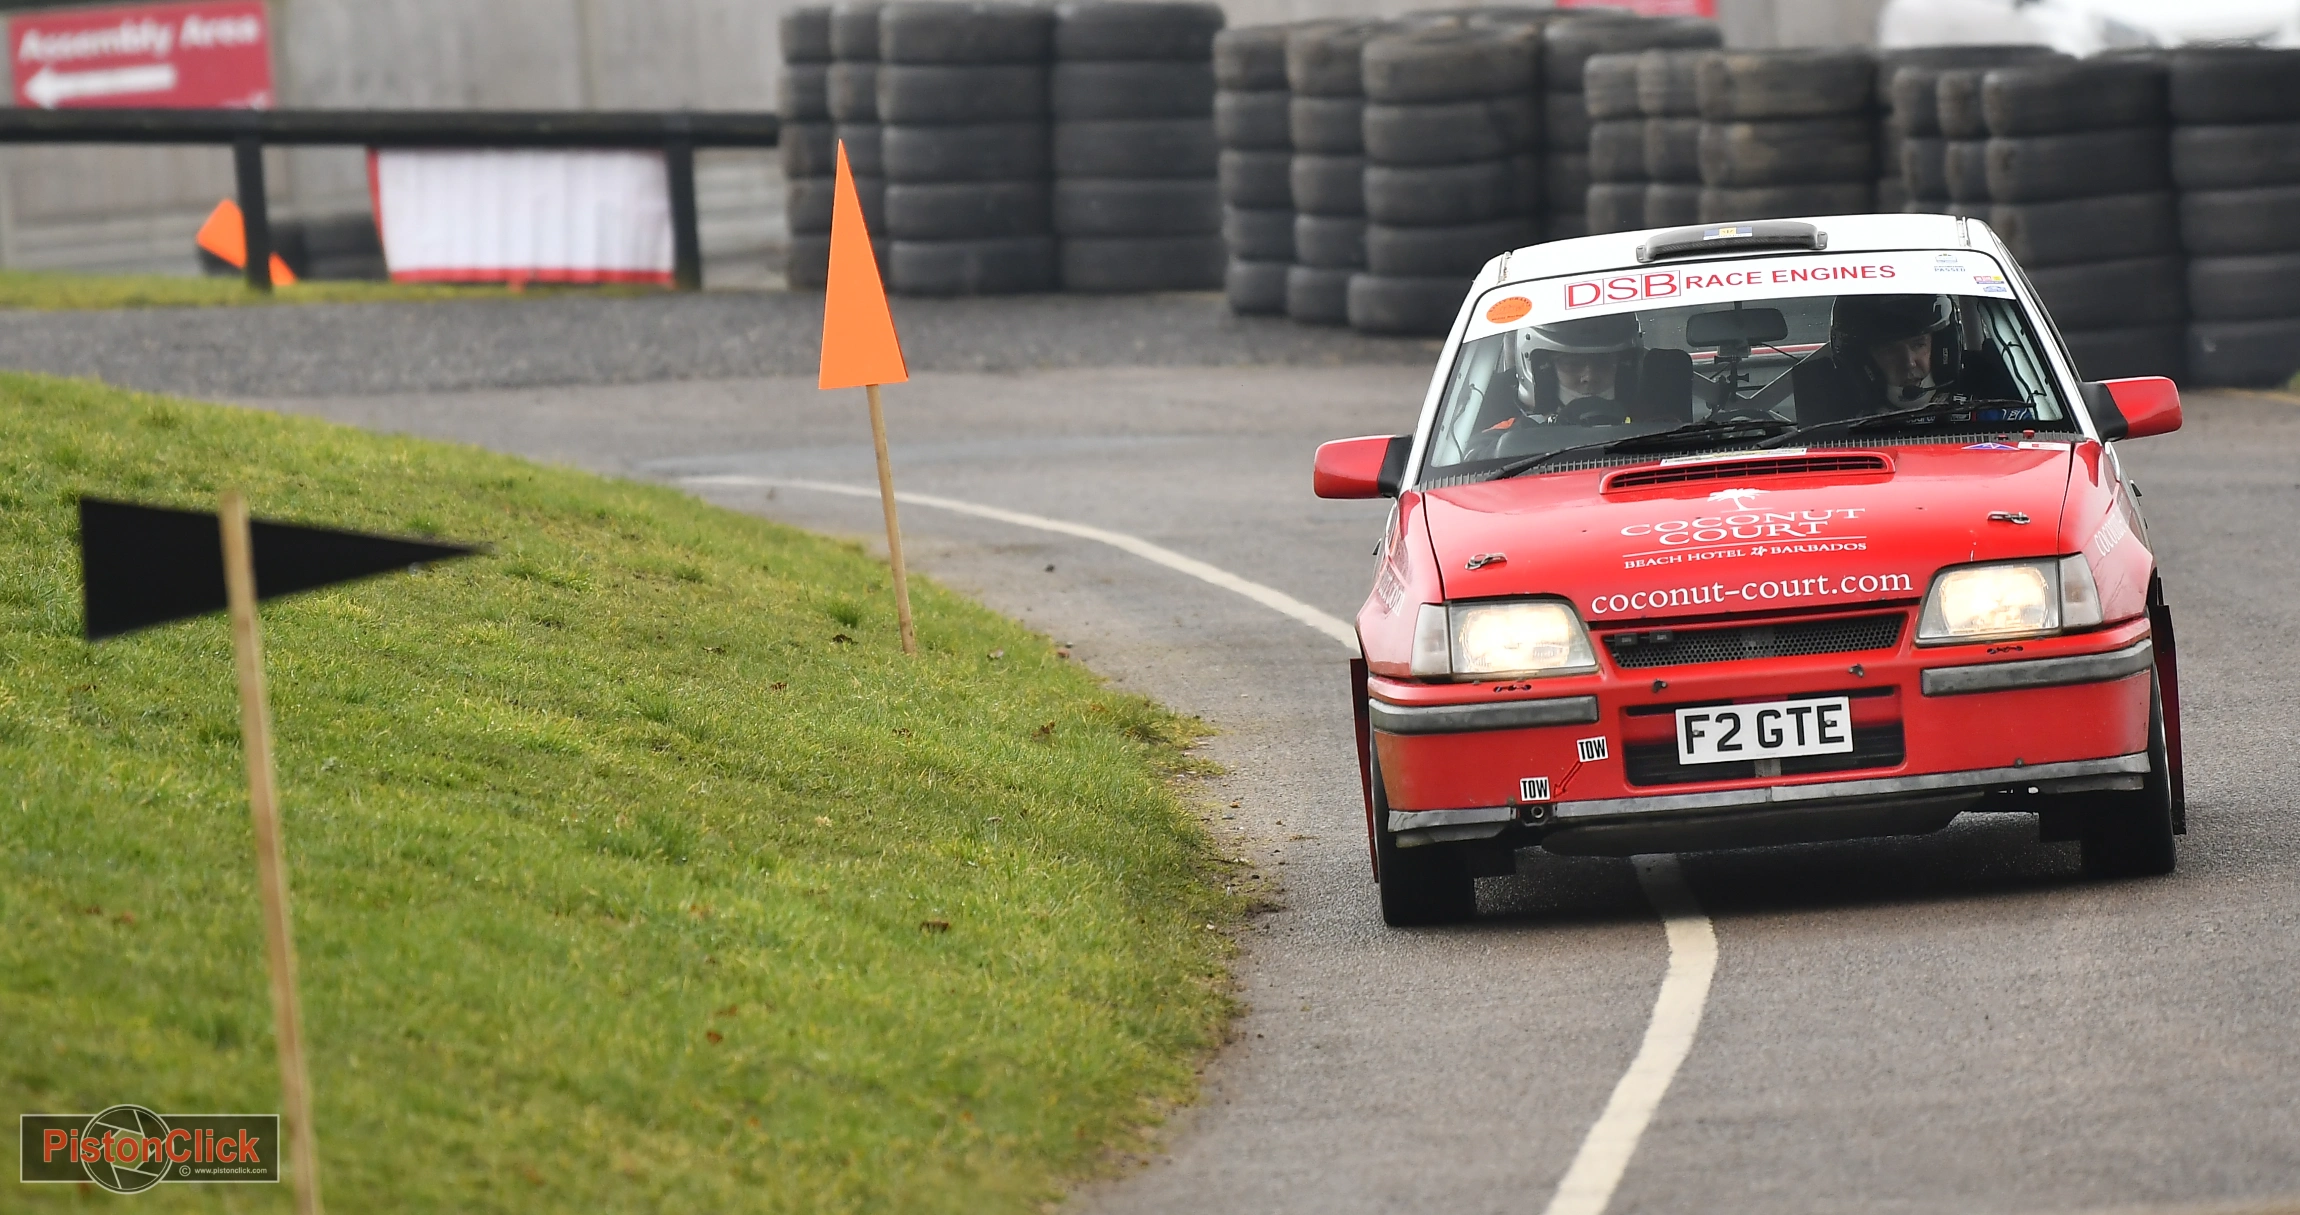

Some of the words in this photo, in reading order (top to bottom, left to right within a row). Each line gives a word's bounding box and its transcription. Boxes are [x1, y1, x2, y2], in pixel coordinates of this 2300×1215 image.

[19, 17, 174, 63] Assembly
[179, 14, 259, 49] Area
[1567, 273, 1678, 308] DSB
[1685, 271, 1763, 290] RACE
[1771, 264, 1896, 284] ENGINES
[1620, 508, 1866, 537] COCONUT
[1658, 520, 1829, 546] COURT
[1623, 554, 1683, 570] BEACH
[1687, 549, 1747, 562] HOTEL
[1770, 542, 1867, 555] BARBADOS
[1591, 572, 1913, 614] coconut-court.com
[1683, 713, 1743, 755] F2
[1756, 703, 1845, 749] GTE
[1578, 738, 1606, 761] TOW
[1521, 779, 1548, 799] TOW
